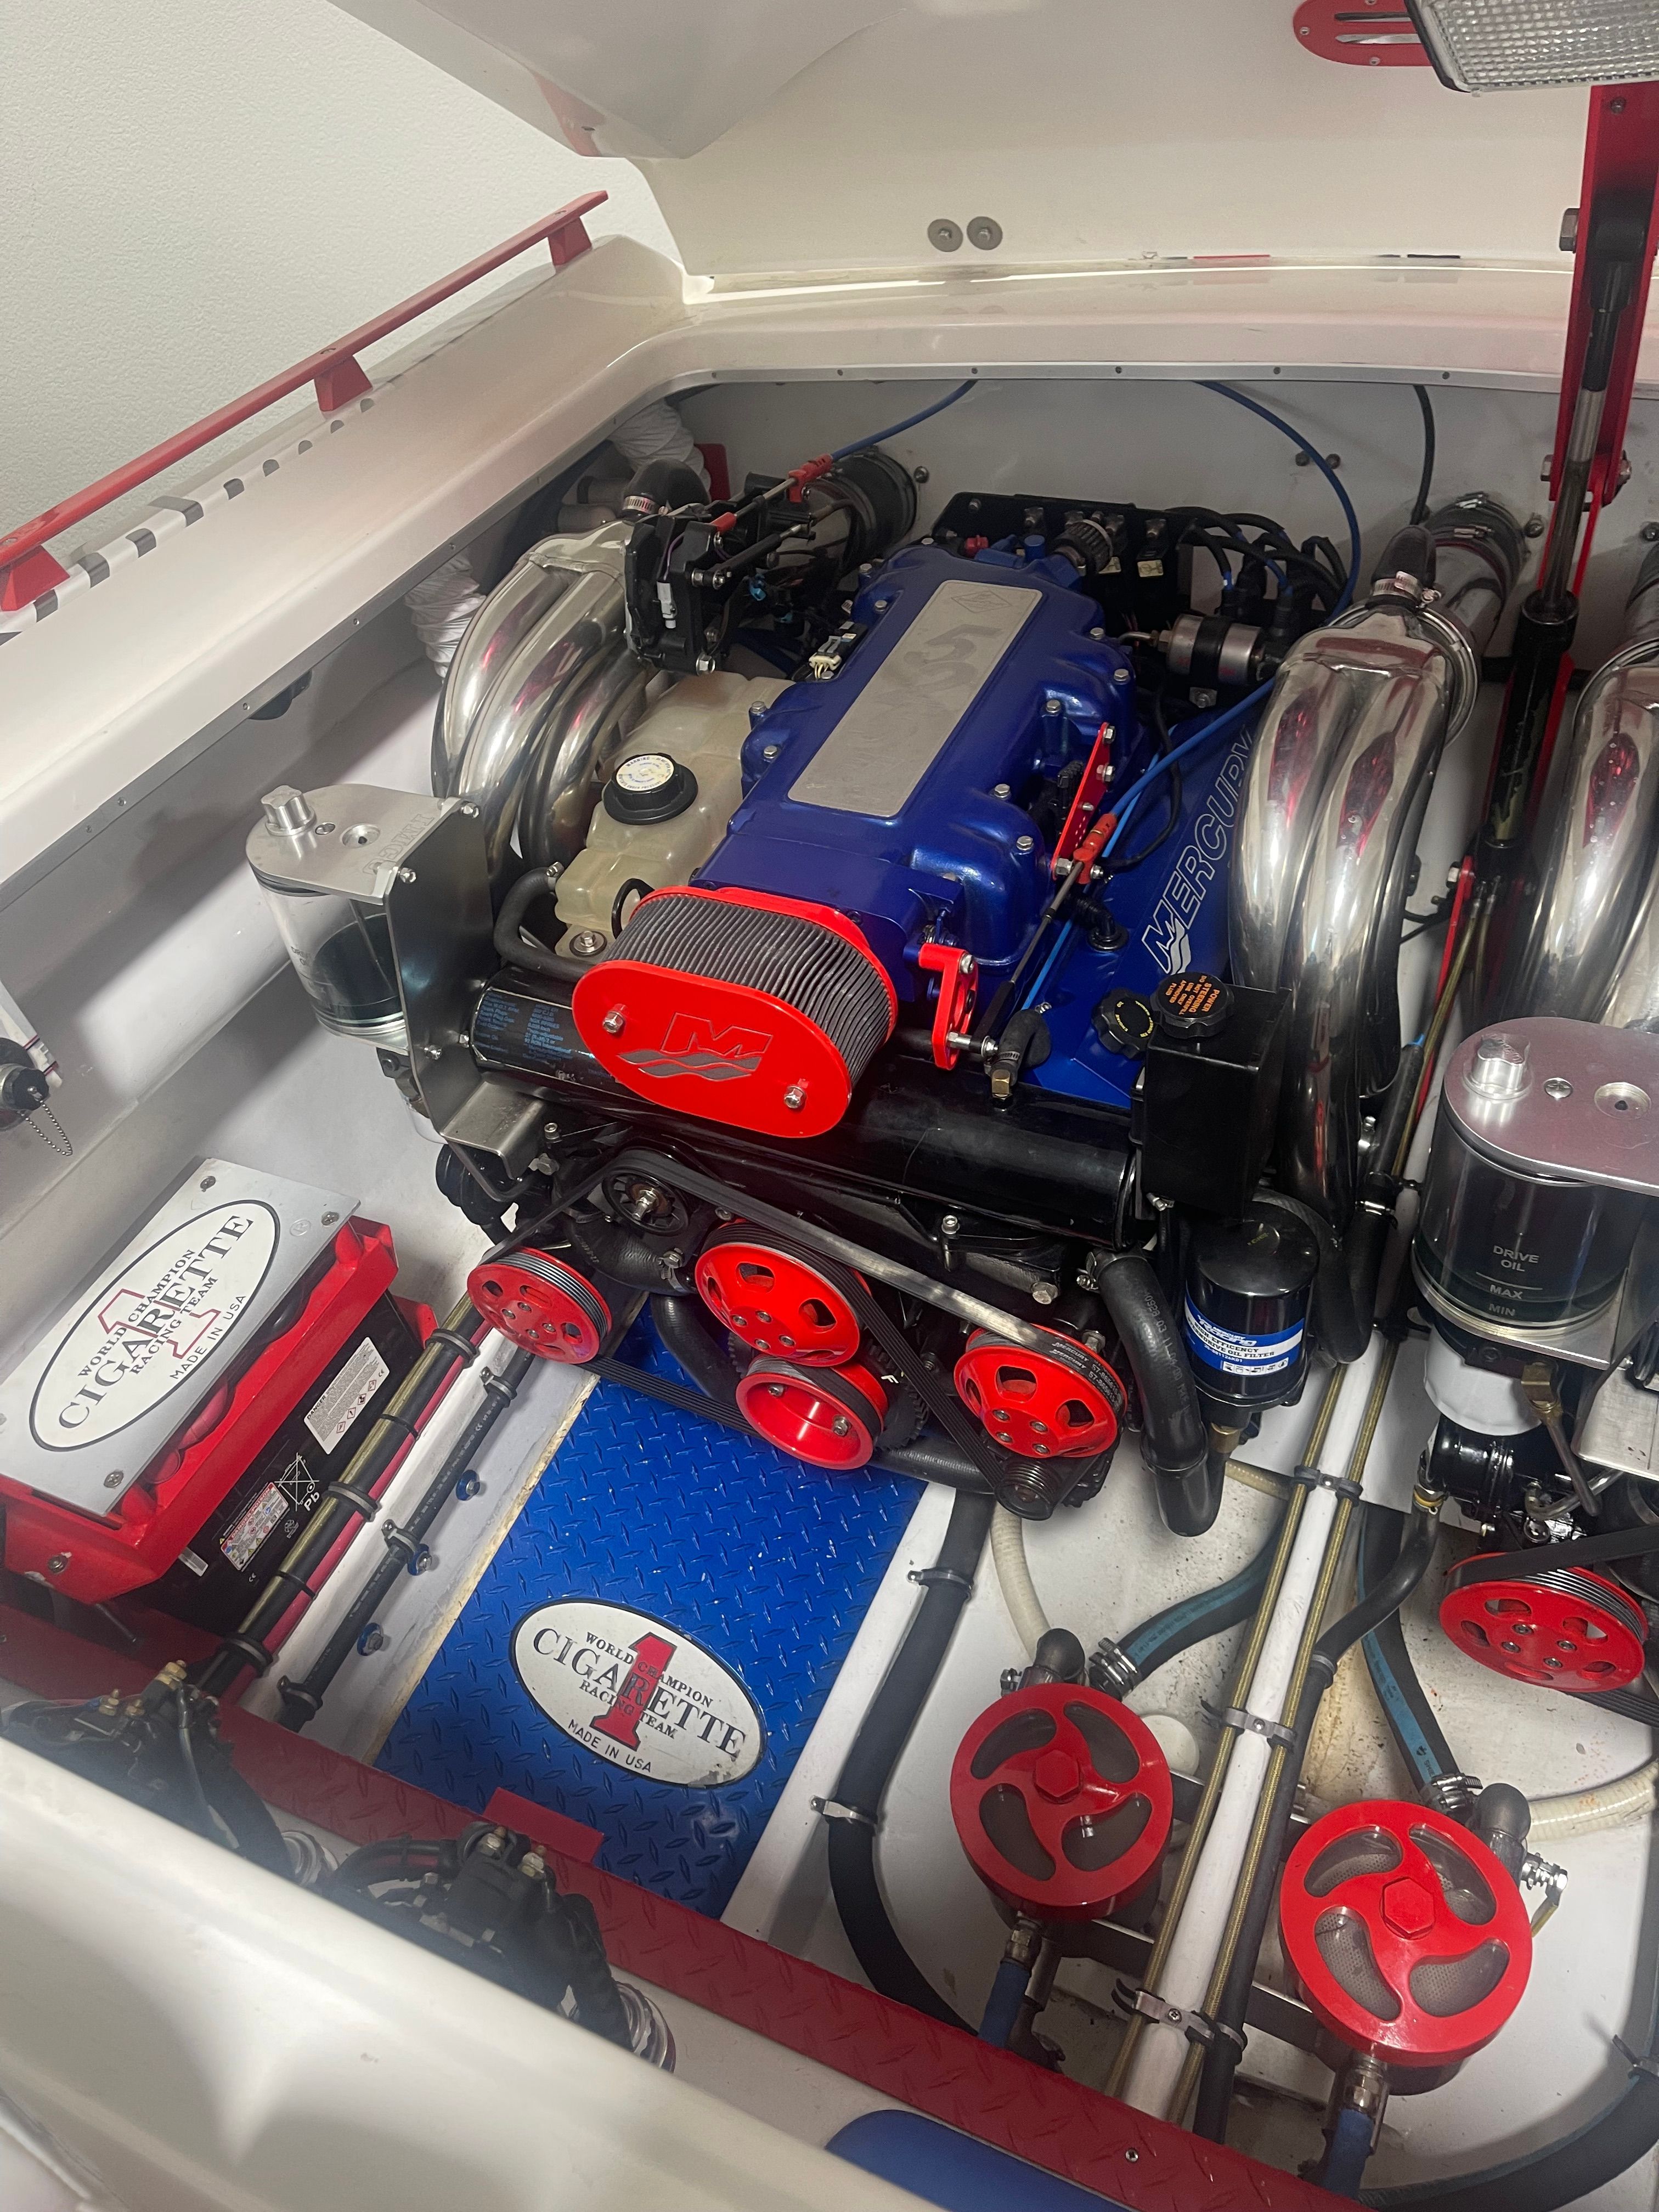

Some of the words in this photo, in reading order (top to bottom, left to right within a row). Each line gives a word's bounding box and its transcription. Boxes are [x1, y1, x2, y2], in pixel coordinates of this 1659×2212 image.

[1188, 983, 1212, 1013] STEERING
[1201, 989, 1220, 1012] POWER
[1492, 1245, 1540, 1263] DRIVE
[1500, 1259, 1525, 1272] OIL
[1489, 1284, 1523, 1300] MAX
[59, 1215, 254, 1429] CIGARETTE
[78, 1327, 127, 1376] WORLD
[128, 1249, 195, 1322] CHAMPION
[1488, 1303, 1516, 1317] MIN
[129, 1319, 182, 1374] RACING
[180, 1277, 218, 1314] TEAM
[170, 1346, 207, 1379] MADE
[207, 1327, 223, 1340] IN
[223, 1295, 246, 1321] USA
[1051, 1342, 1089, 1362] MERCURY
[307, 1395, 326, 1420] DANGER
[304, 1492, 320, 1511] Pb
[586, 1632, 635, 1664] WORLD
[637, 1661, 713, 1708] CHAMPION
[533, 1628, 747, 1761] CIGARETTE
[579, 1679, 634, 1715] RACING
[639, 1710, 676, 1740] TEAM
[568, 1719, 599, 1748] MADE
[605, 1744, 619, 1759] IN
[625, 1754, 652, 1773] USA
